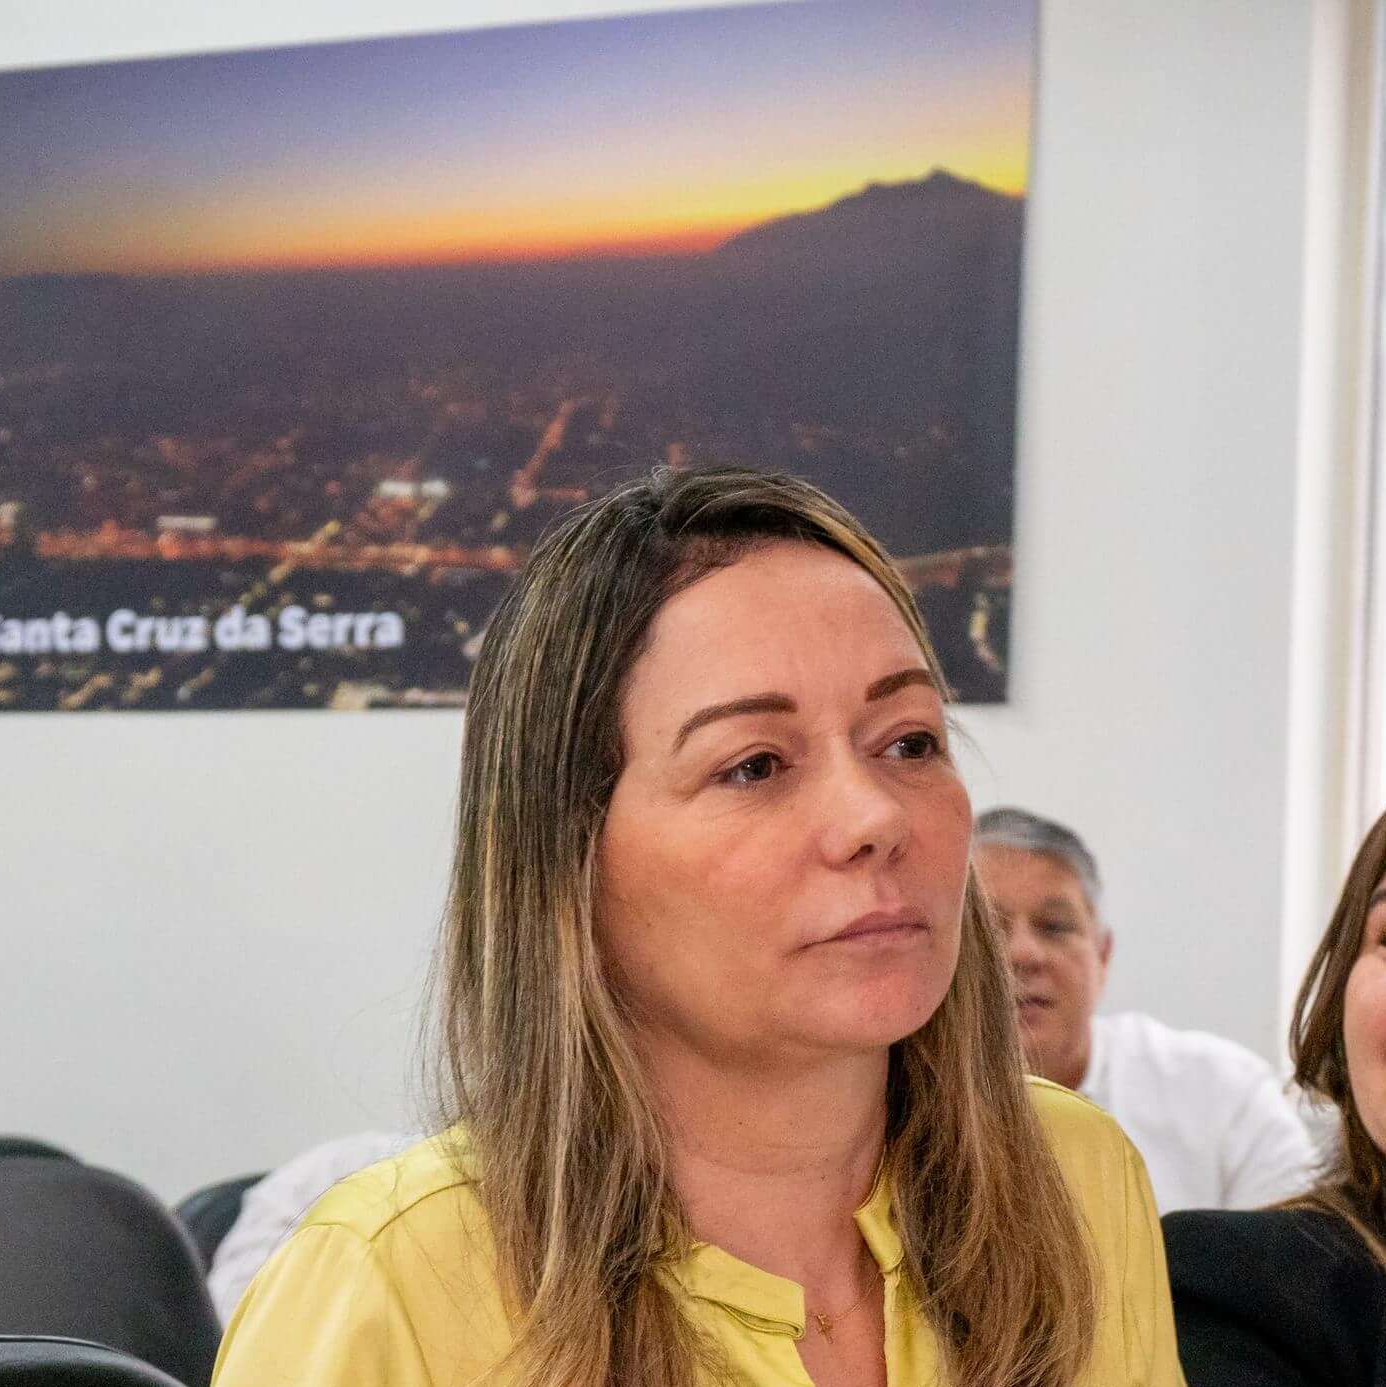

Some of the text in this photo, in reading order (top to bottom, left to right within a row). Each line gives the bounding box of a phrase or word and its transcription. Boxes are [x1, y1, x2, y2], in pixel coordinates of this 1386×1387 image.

[106, 608, 208, 653] Cruz
[215, 604, 272, 651] da
[277, 604, 404, 651] Serra
